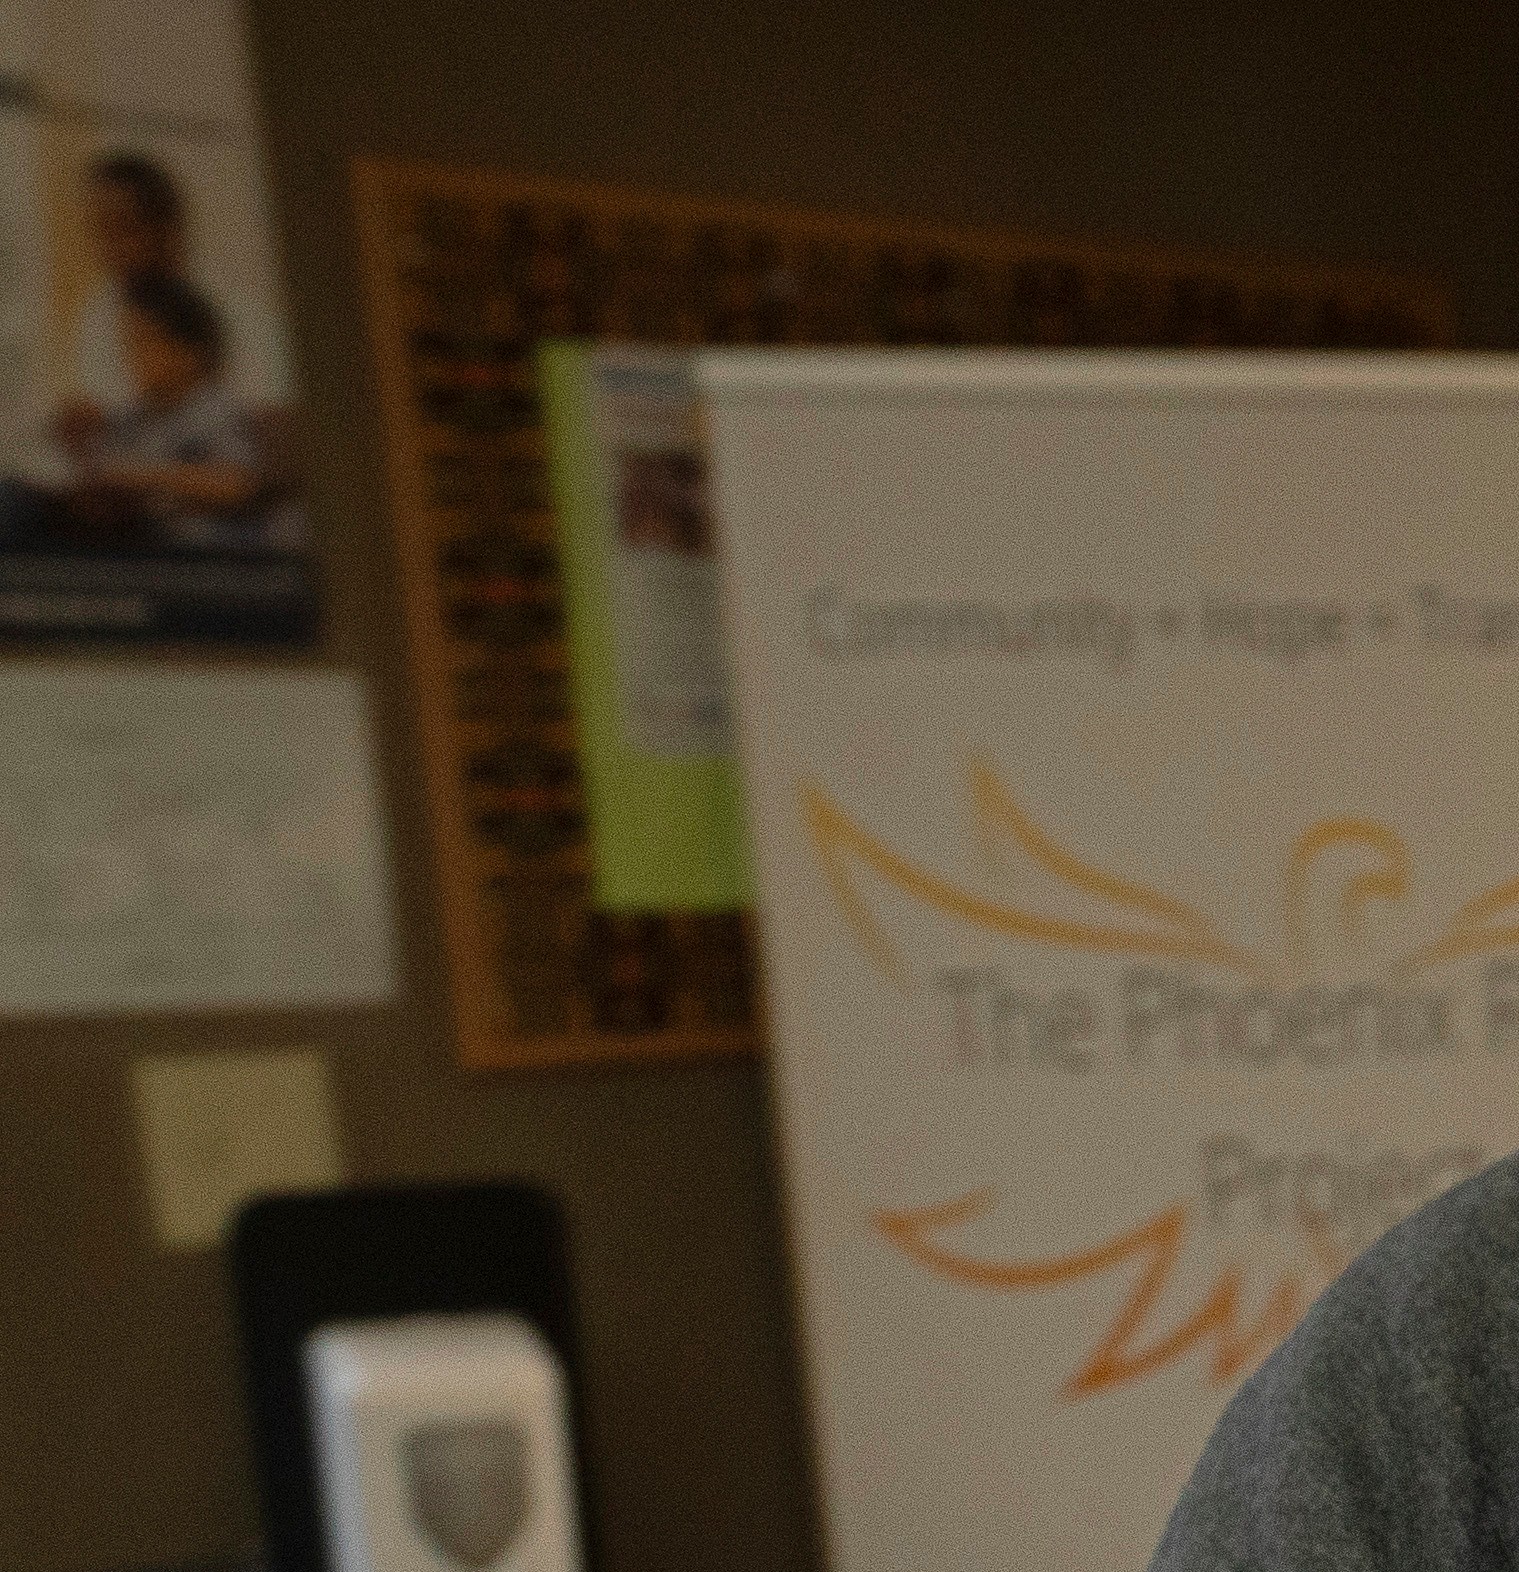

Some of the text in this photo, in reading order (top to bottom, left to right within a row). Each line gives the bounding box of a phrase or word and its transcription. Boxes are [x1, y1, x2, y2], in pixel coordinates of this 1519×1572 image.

[804, 580, 1136, 676] Community
[1200, 588, 1350, 666] Hope
[935, 965, 1094, 1072] The
[1120, 965, 1455, 1066] Phoenix
[1200, 1132, 1484, 1244] Projec
